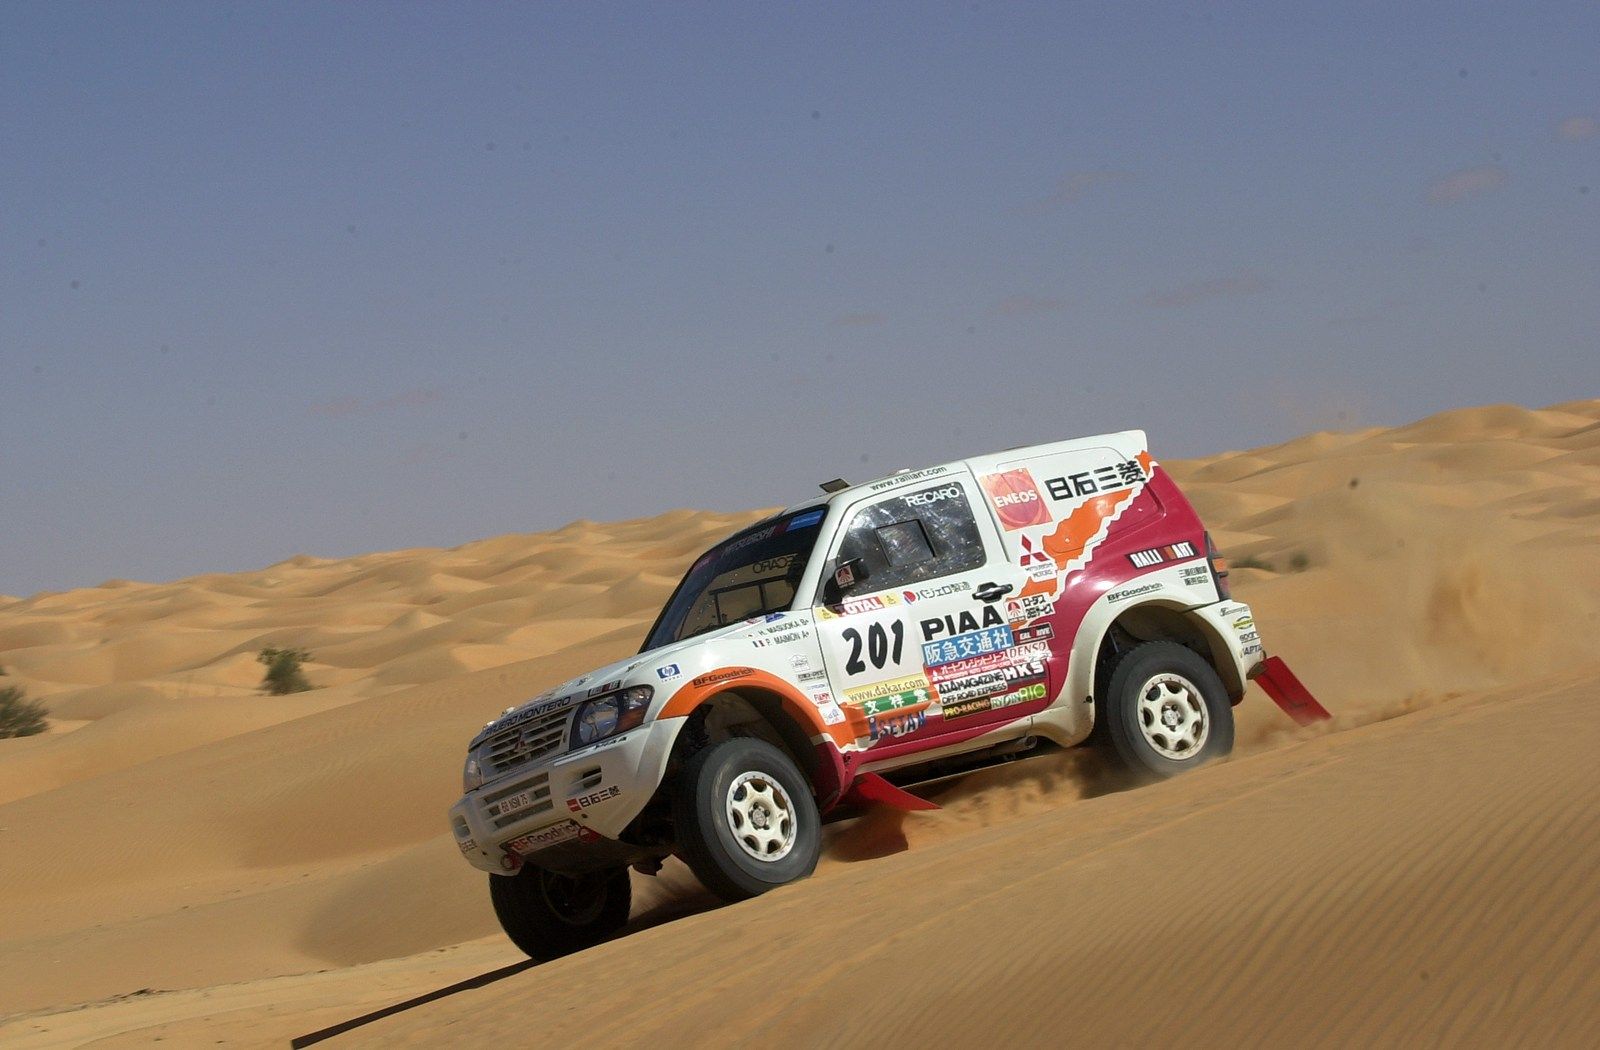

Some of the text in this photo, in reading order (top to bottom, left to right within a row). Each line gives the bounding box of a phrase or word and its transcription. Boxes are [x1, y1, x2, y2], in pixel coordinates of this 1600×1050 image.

[870, 466, 947, 490] www.ralliart.com
[1045, 461, 1146, 501] 日石三菱
[905, 486, 960, 507] RECARO
[994, 489, 1038, 507] ENEOS
[1107, 583, 1163, 602] BFGoodrich
[920, 604, 1005, 642] PIAA
[842, 619, 904, 676] 201
[923, 628, 1012, 665] 阪急交通社
[1009, 641, 1046, 658] DENSO
[692, 667, 755, 687] BFGoodrich
[1003, 661, 1045, 681] HKS
[847, 679, 925, 702] www.dakar.com
[517, 696, 571, 721] MONTERO
